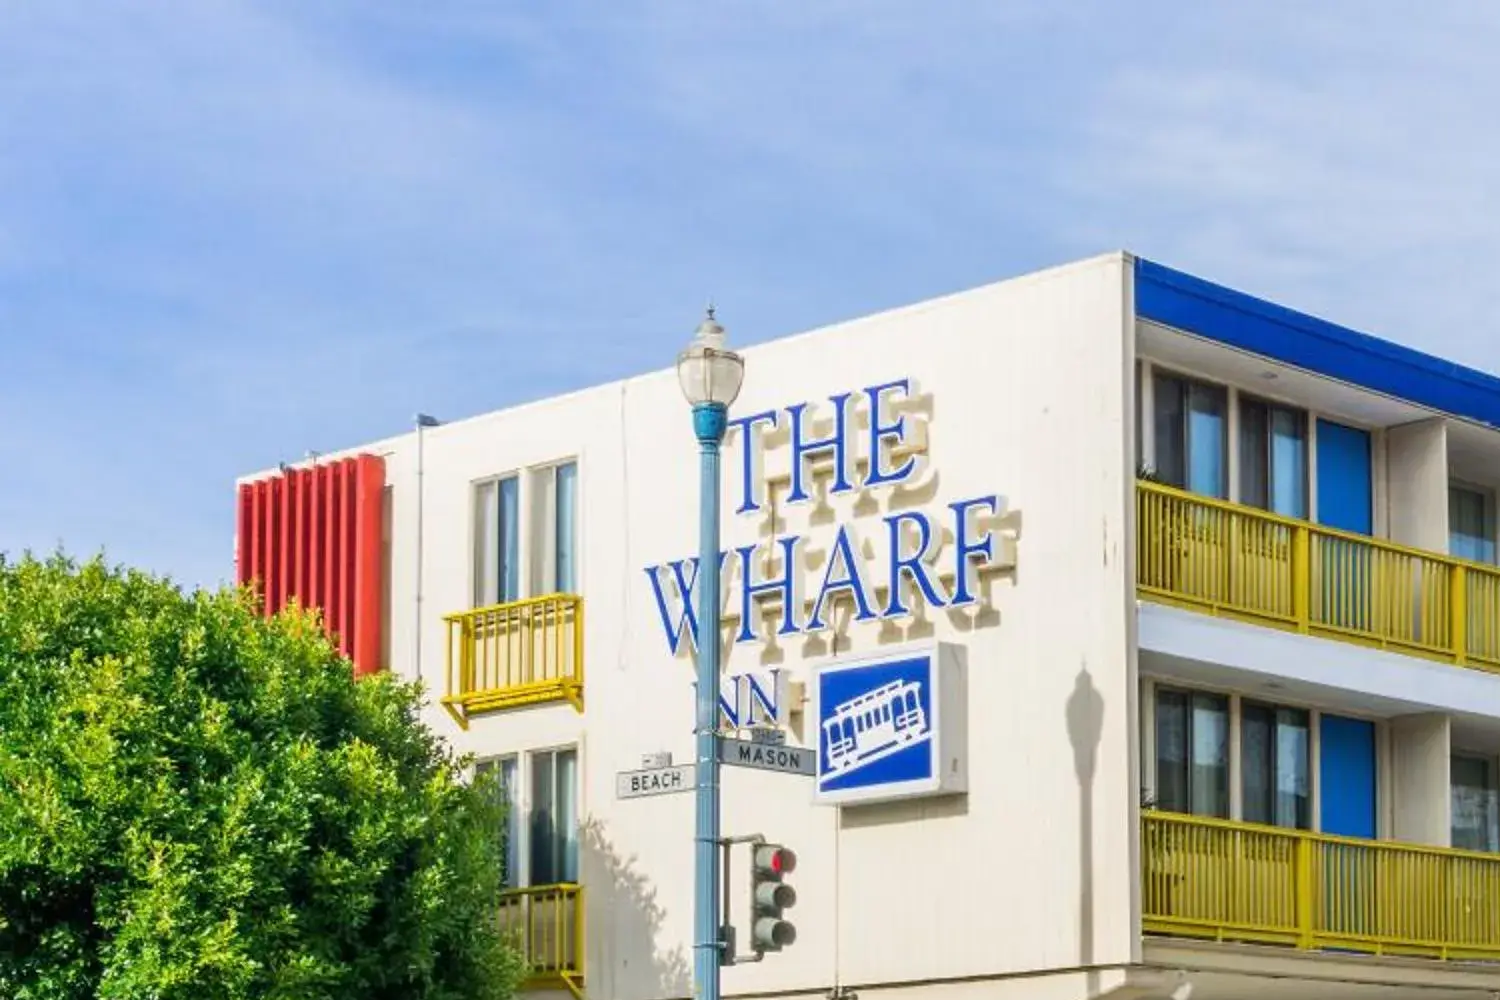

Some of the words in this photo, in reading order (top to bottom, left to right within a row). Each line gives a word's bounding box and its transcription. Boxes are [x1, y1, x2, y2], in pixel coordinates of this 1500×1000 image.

[728, 378, 915, 515] THE
[644, 495, 998, 656] WHARF
[692, 668, 780, 733] NN
[631, 771, 681, 792] BEACH
[738, 746, 800, 768] MASON
